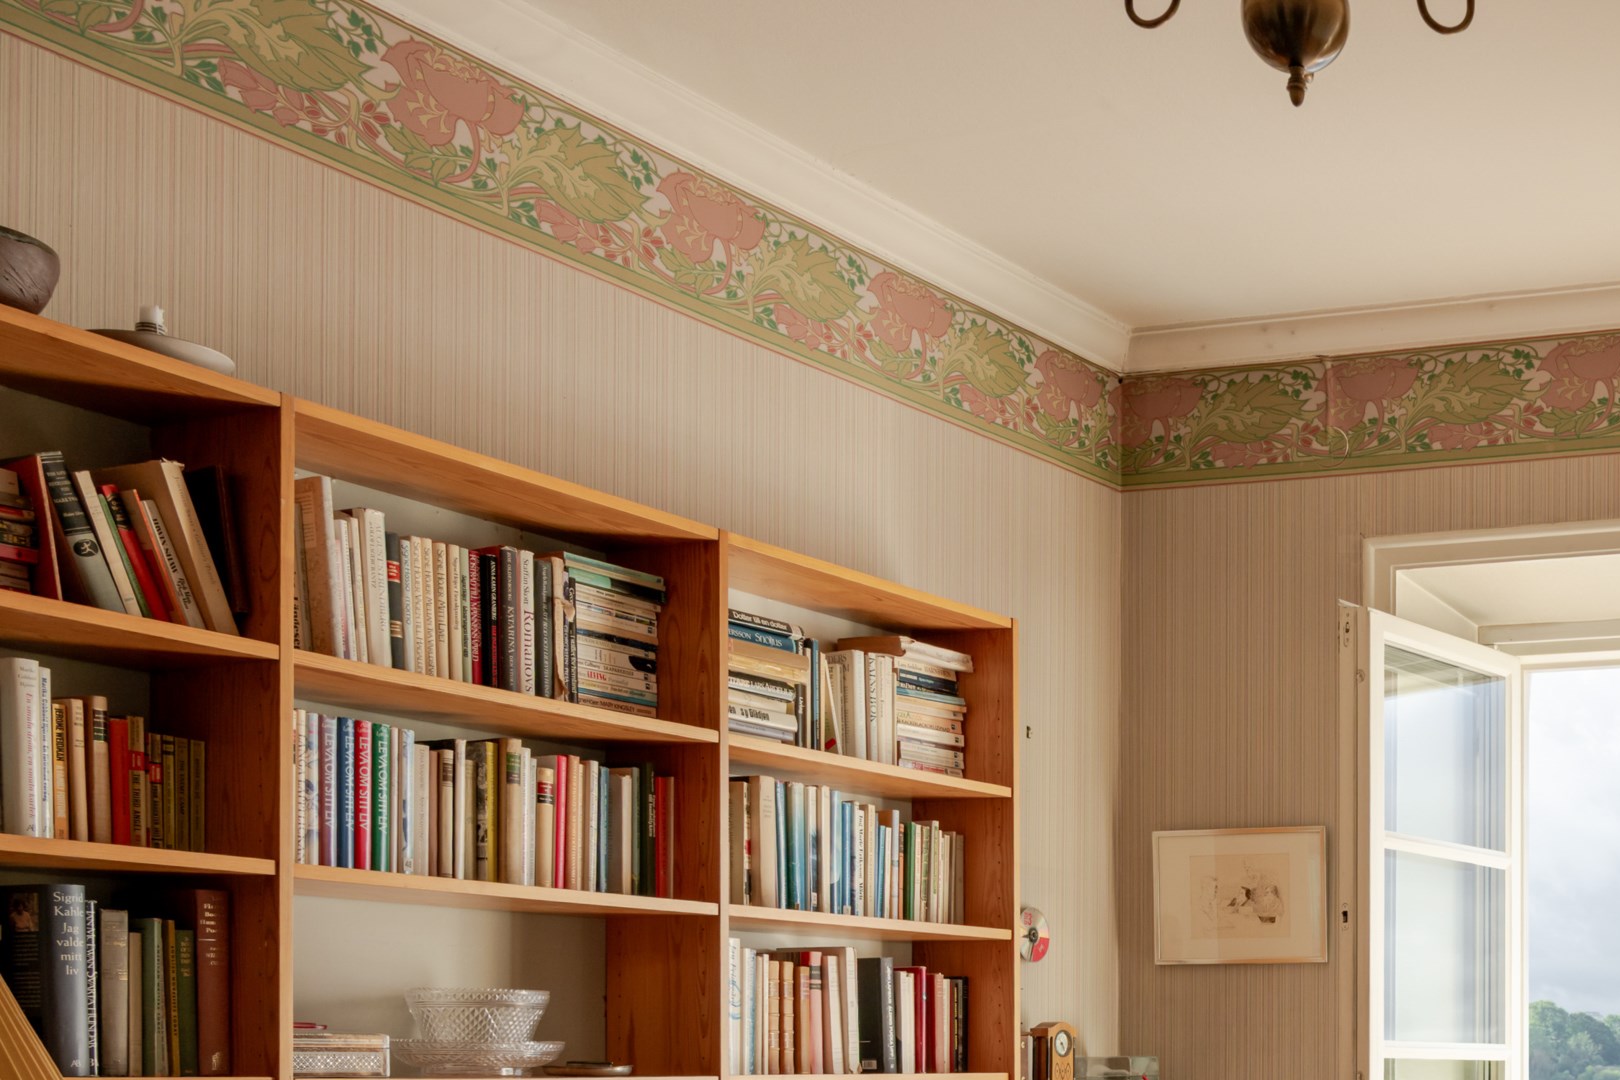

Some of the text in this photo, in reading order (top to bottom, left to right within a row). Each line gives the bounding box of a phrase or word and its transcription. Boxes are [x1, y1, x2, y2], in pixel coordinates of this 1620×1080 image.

[522, 558, 530, 584] Staffan
[377, 565, 386, 632] STRINDBERG
[507, 605, 515, 653] KATARINA
[523, 610, 535, 693] Romanovs
[55, 708, 65, 761] JEROME WEIDMAN
[325, 733, 334, 761] LEVA
[345, 736, 354, 764] LEVA
[359, 736, 369, 764] LEVA
[378, 740, 387, 769] LEVA
[133, 787, 141, 808] THIRD
[133, 809, 141, 832] ANGEL
